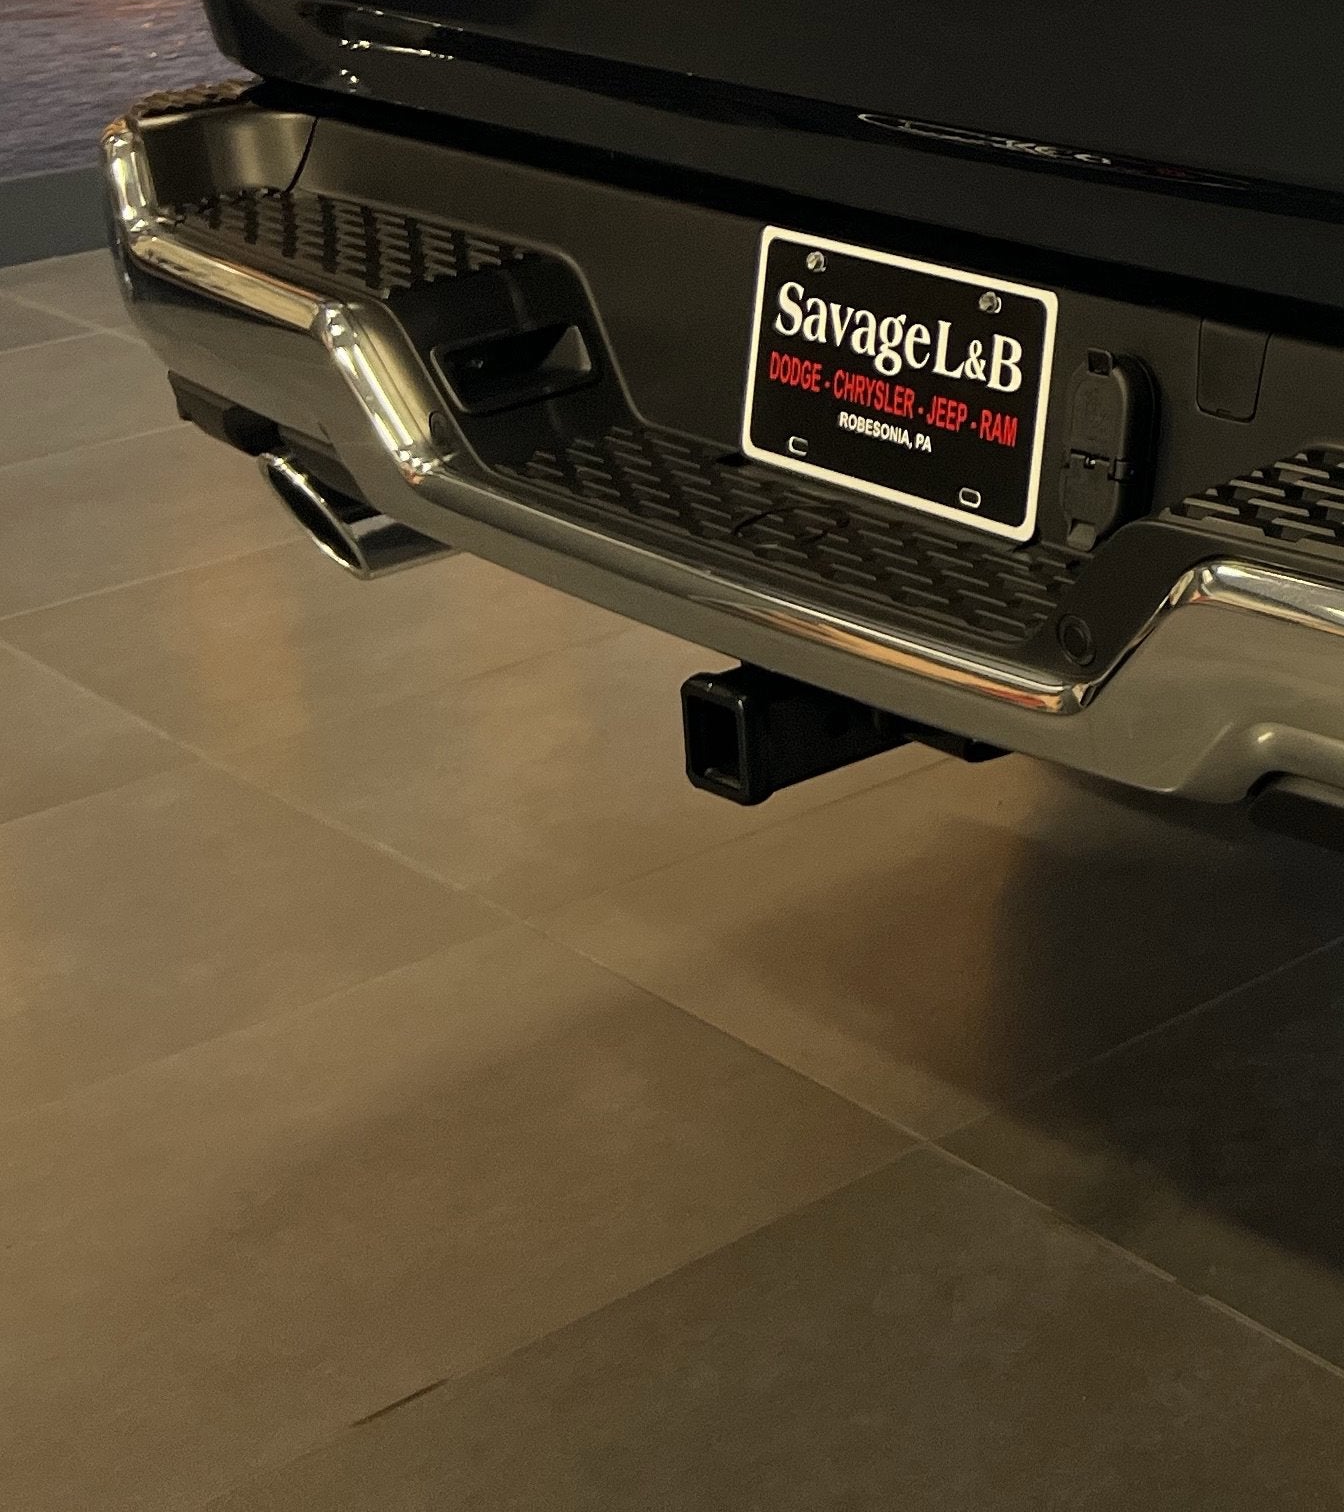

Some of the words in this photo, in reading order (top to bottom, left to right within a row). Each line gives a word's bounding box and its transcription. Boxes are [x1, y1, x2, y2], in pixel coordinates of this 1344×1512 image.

[768, 350, 822, 393] DODGE
[833, 369, 915, 419] CHRYSLER
[926, 395, 968, 432] JEEP
[979, 408, 1018, 448] RAM
[838, 411, 913, 450] ROBESONIA,
[915, 433, 932, 453] PA
